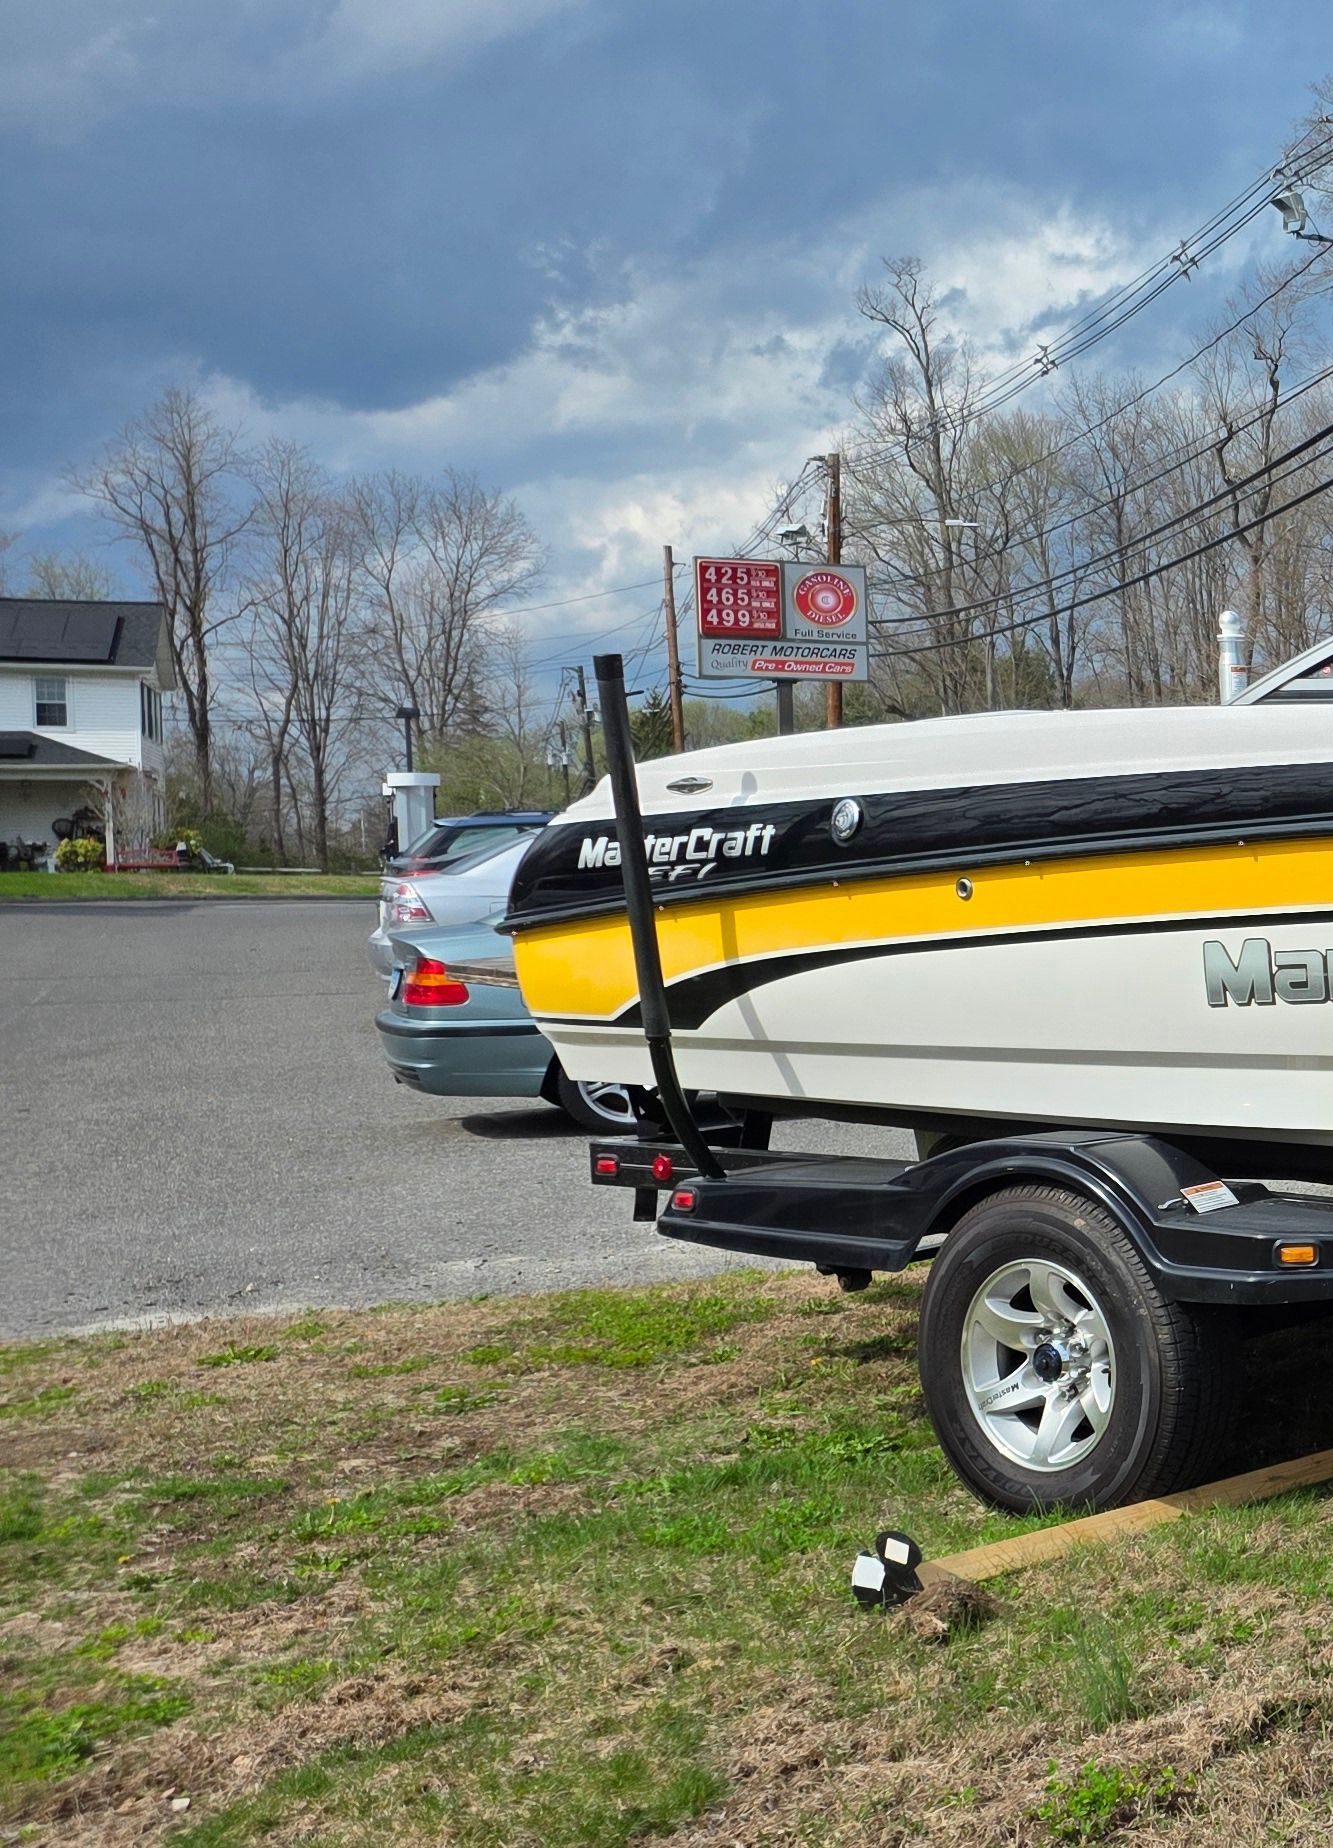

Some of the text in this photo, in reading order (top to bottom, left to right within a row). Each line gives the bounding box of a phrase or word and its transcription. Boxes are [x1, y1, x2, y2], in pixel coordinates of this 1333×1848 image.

[705, 566, 748, 585] 425
[799, 575, 852, 597] GASOLINE
[706, 587, 749, 606] 465
[706, 608, 750, 627] 499
[807, 610, 846, 623] DIESEL
[794, 629, 857, 639] Full Service
[711, 643, 857, 659] ROBERT MOTORCARS
[711, 656, 748, 671] Quality
[754, 661, 775, 669] Pre
[784, 661, 824, 672] Owned
[825, 664, 852, 673] Cars
[578, 823, 776, 869] MaterCraft
